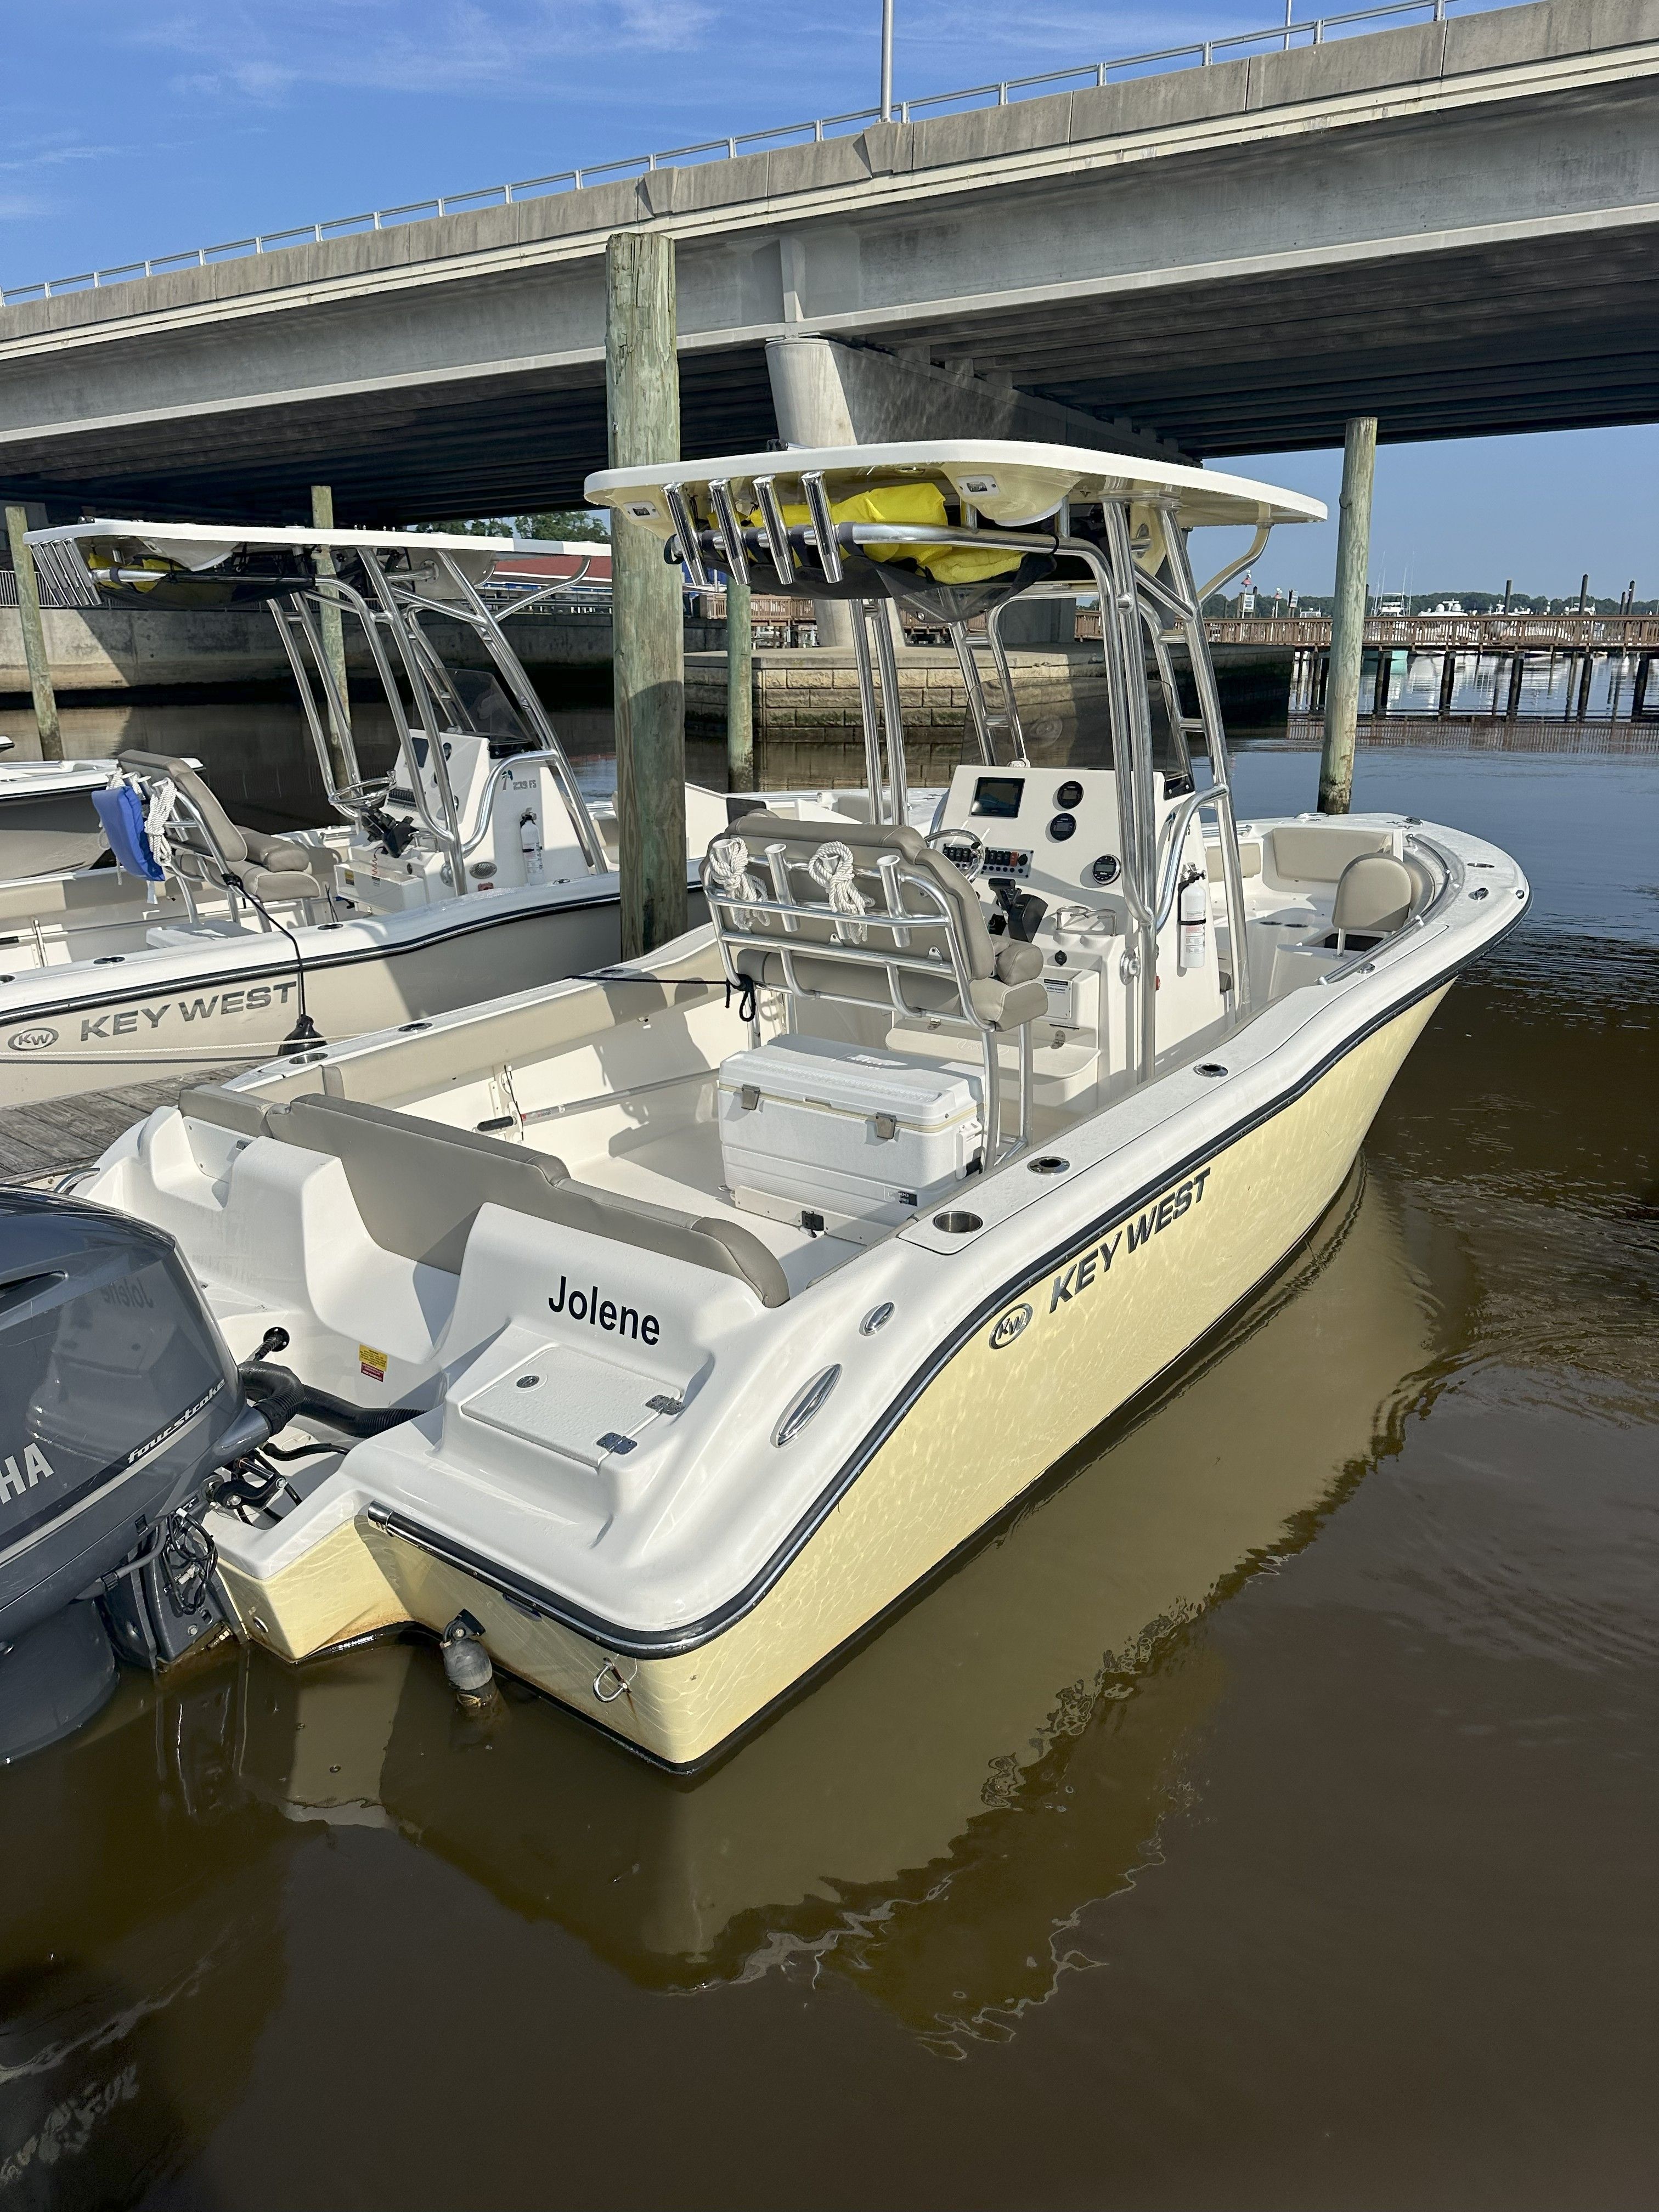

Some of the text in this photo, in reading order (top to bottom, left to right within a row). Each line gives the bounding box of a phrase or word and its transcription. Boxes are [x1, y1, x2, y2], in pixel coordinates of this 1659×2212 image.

[81, 981, 297, 1041] KEY WEST
[1049, 1167, 1211, 1314] KEY WEST
[549, 1275, 659, 1345] Jolene
